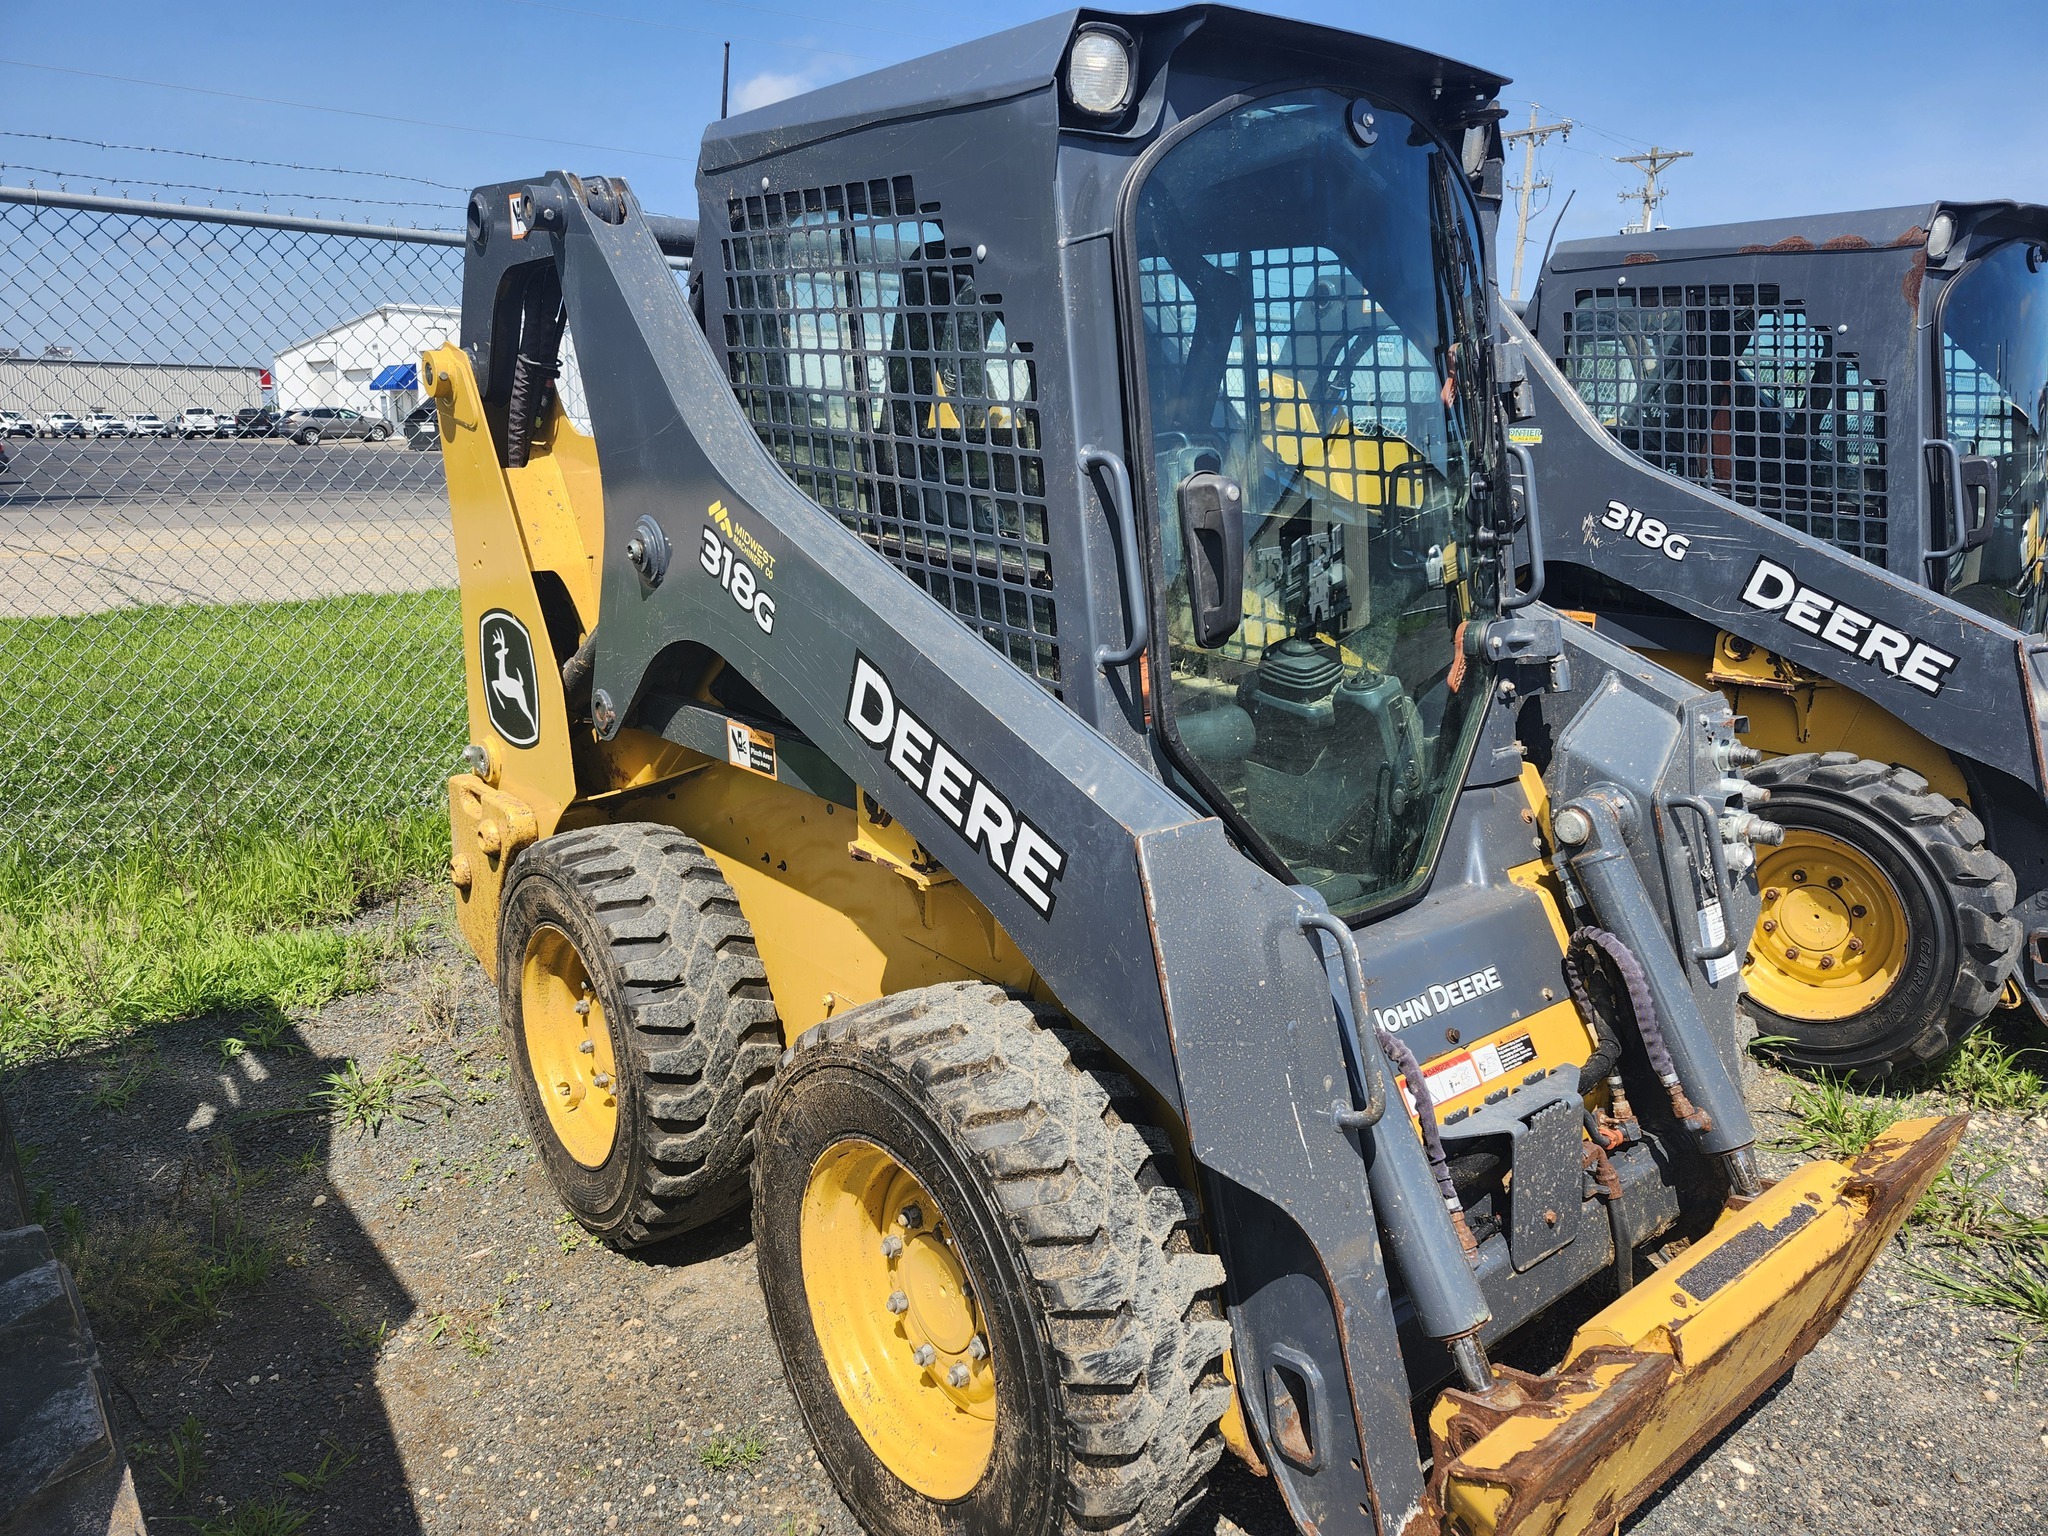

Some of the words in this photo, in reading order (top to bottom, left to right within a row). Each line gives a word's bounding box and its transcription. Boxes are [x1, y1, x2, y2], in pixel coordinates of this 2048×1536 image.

[732, 534, 765, 571] MACHINERY
[765, 567, 774, 580] CO
[734, 522, 776, 568] MIDWEST
[1601, 500, 1691, 562] 318G
[700, 526, 776, 635] 318G
[1742, 559, 1955, 693] DEERE
[847, 657, 1063, 912] DEERE
[1373, 994, 1433, 1034] JOHN
[1428, 966, 1502, 1014] DEERE
[1427, 1062, 1451, 1076] DANGER
